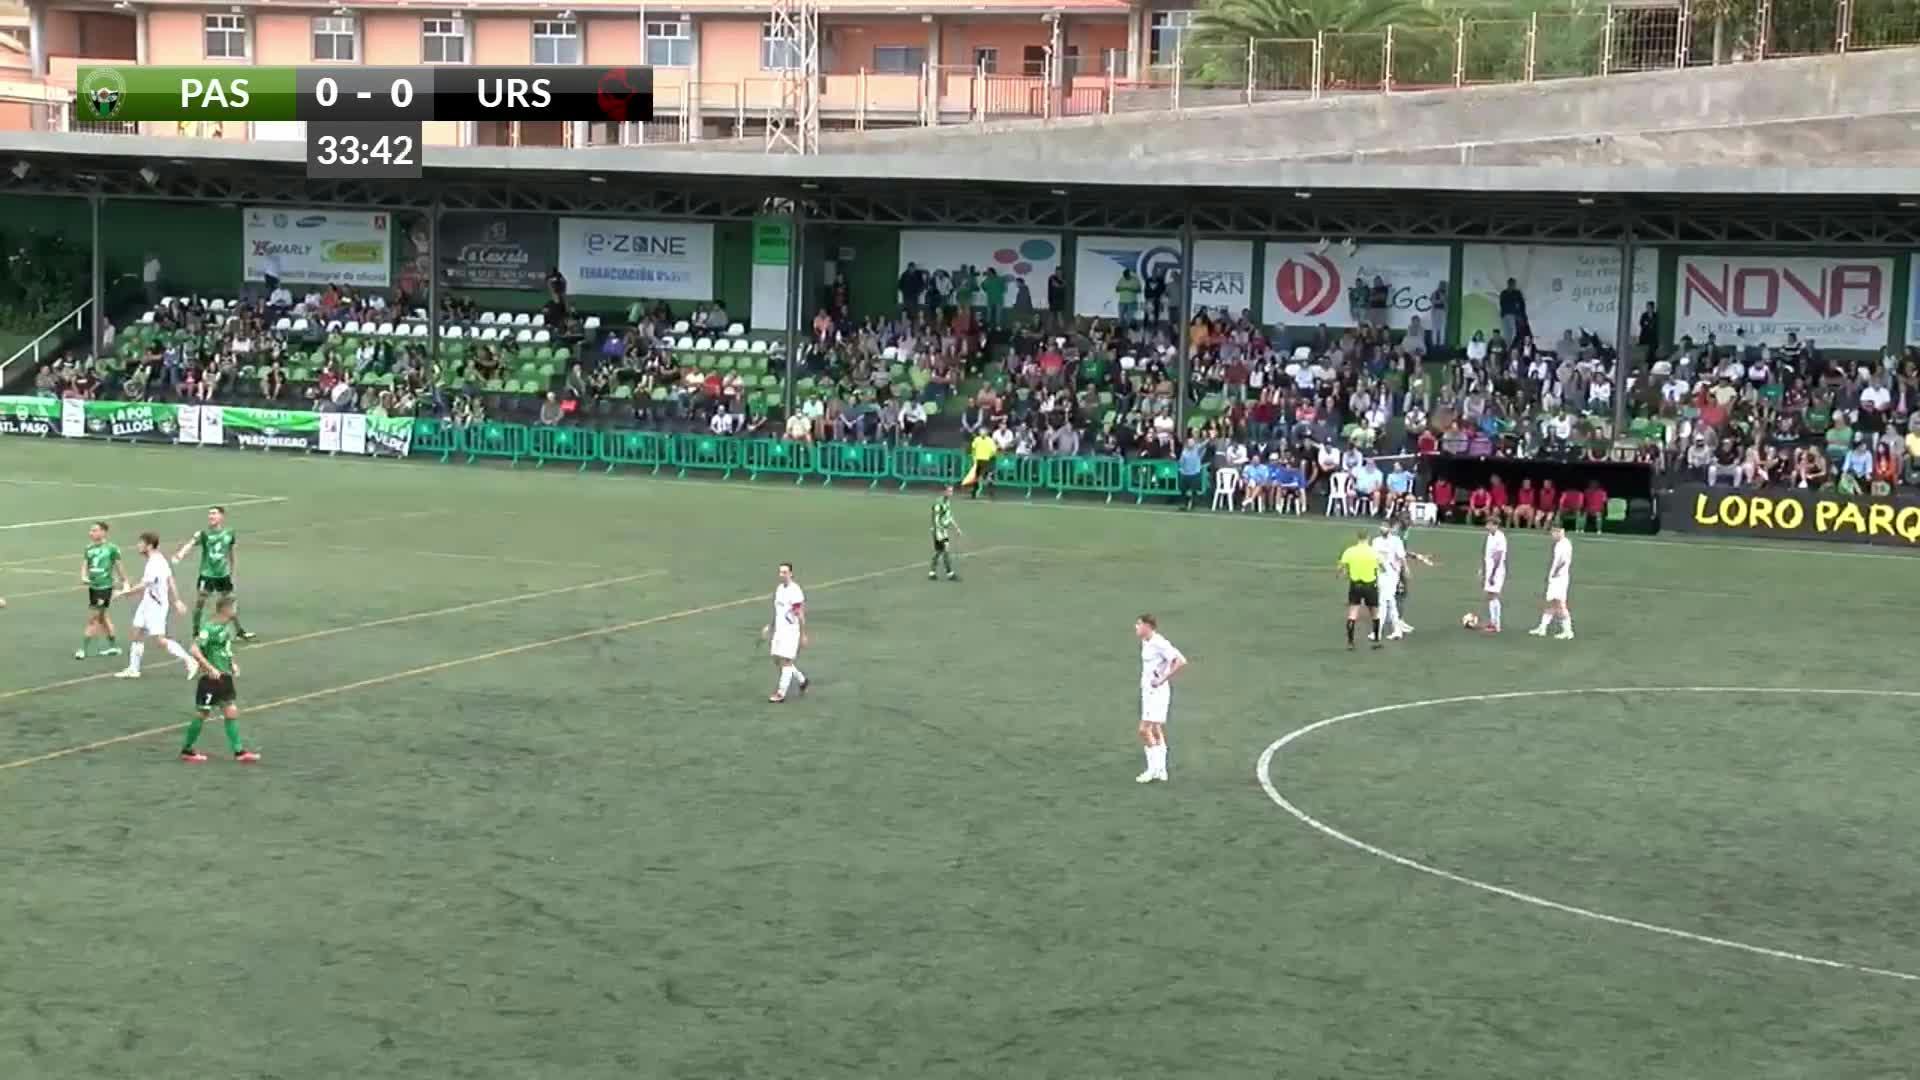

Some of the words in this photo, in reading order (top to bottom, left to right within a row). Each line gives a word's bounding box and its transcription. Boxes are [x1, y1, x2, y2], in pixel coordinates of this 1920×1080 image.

[1684, 263, 1882, 318] NOVA
[20, 422, 49, 434] PASO
[1695, 493, 1804, 529] LORO
